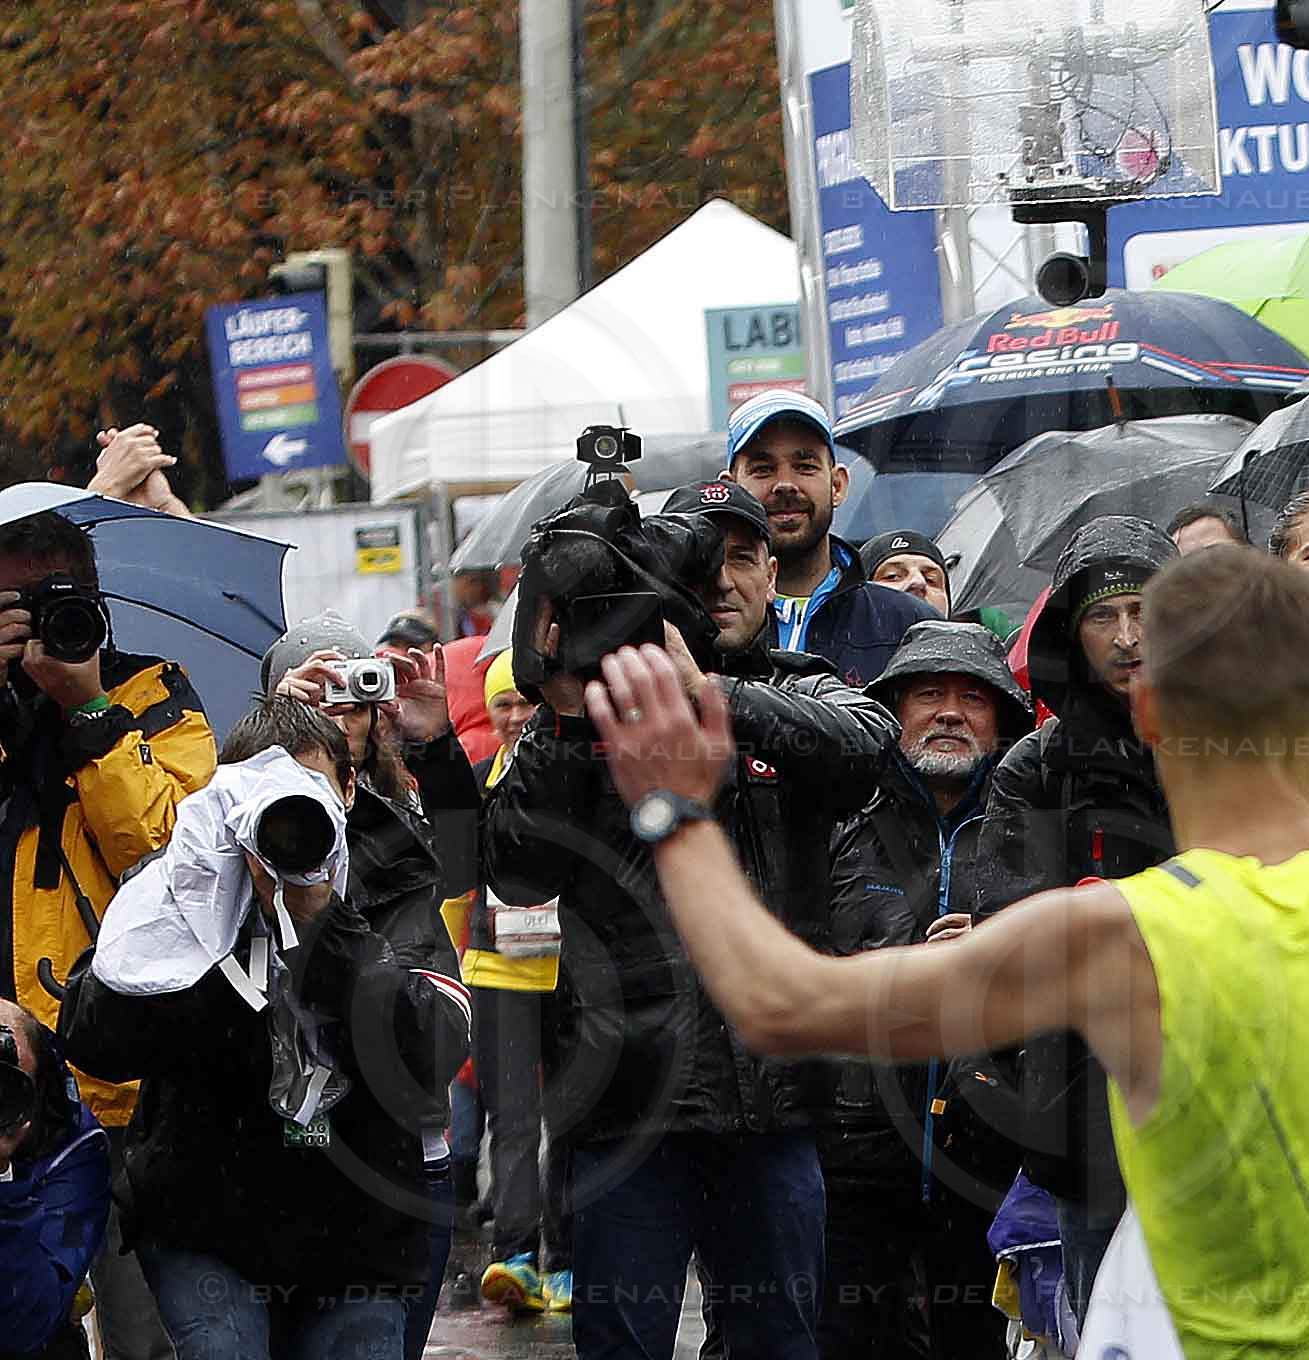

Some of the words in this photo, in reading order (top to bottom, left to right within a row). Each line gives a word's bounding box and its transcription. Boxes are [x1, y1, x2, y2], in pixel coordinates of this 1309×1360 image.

[724, 309, 801, 351] LAB
[987, 330, 1053, 353] Red
[1055, 321, 1121, 345] Bull
